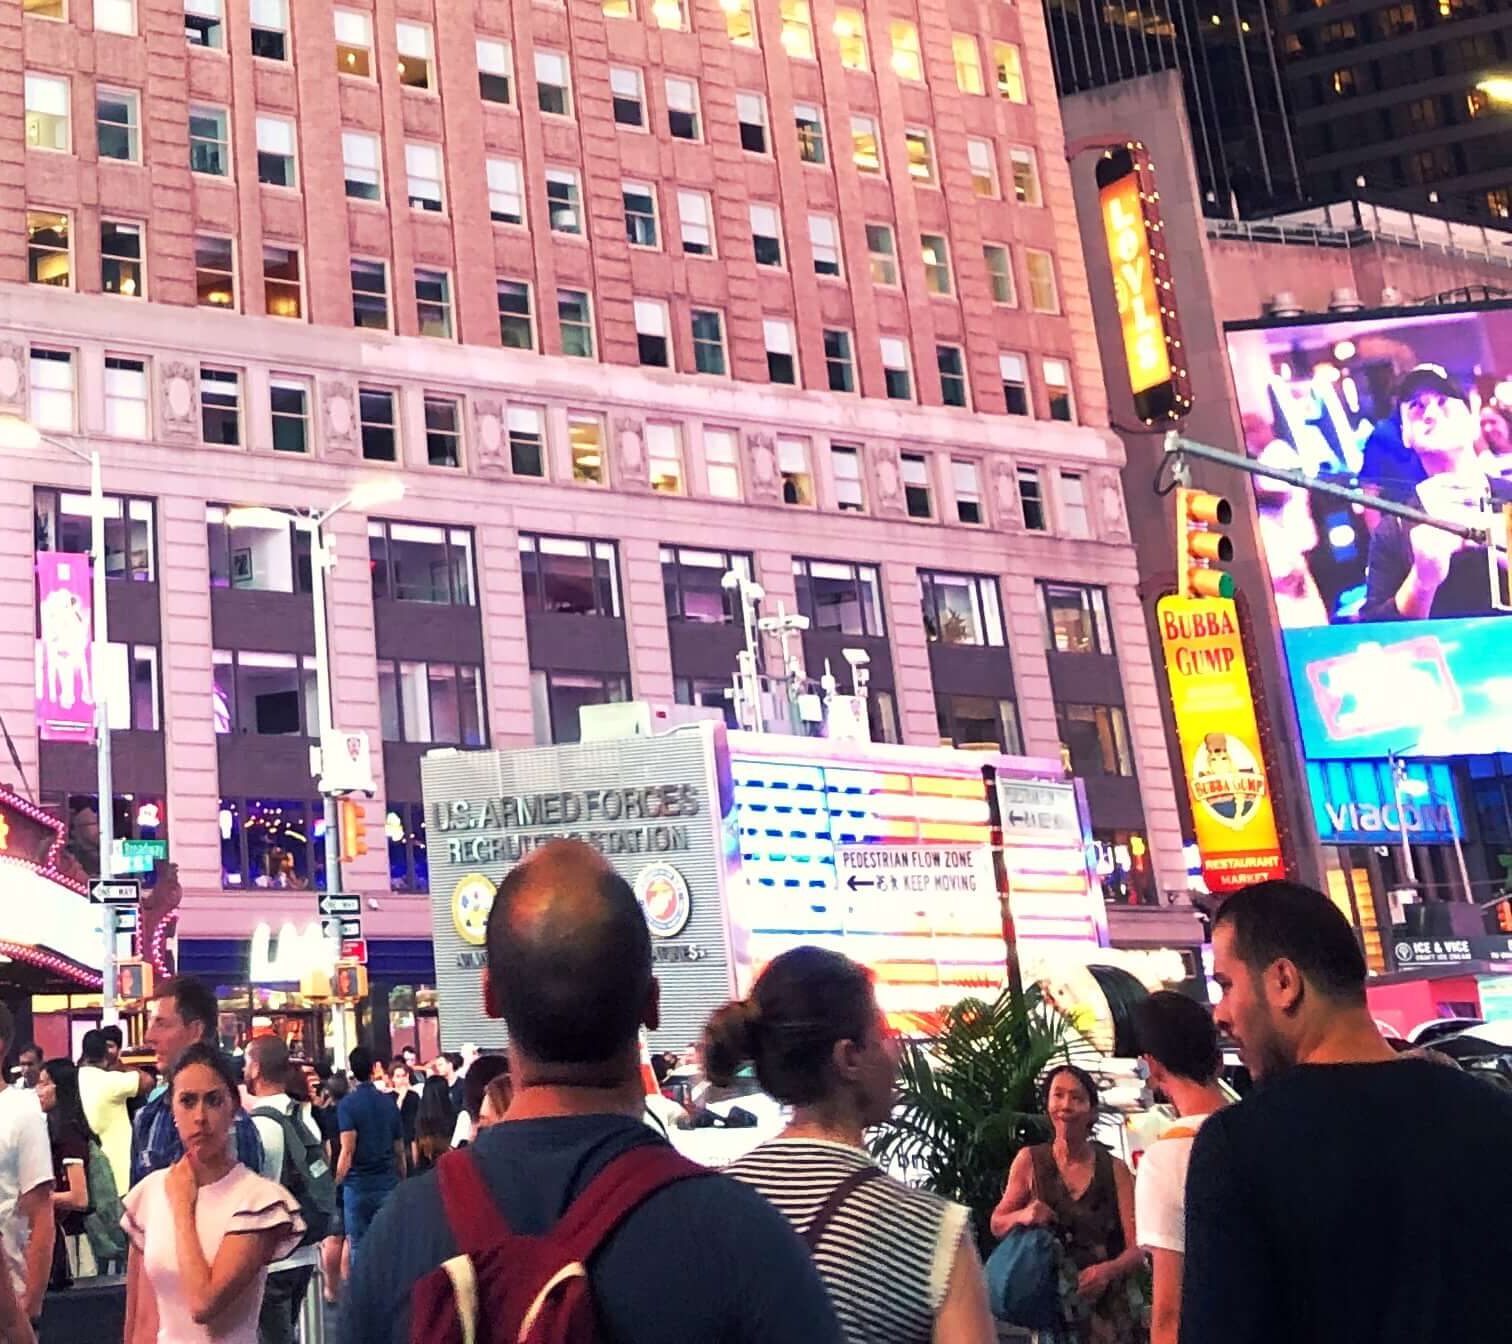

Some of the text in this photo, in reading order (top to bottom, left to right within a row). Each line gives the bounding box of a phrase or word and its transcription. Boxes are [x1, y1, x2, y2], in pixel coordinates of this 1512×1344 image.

[1164, 610, 1235, 641] BUBBA
[1175, 647, 1235, 677] GUMP
[1195, 776, 1264, 797] BUBBA GUMP
[432, 783, 700, 832] U.S. ARMED FORCES
[843, 851, 974, 869] PEDESTRIAN FLOW ZONE
[1205, 855, 1280, 870] RESTAURANT
[904, 875, 977, 892] KEEP MOVING
[1219, 871, 1270, 885] MARKET
[118, 887, 134, 897] WAY
[1413, 941, 1432, 954] ICE
[1444, 940, 1471, 953] VICE
